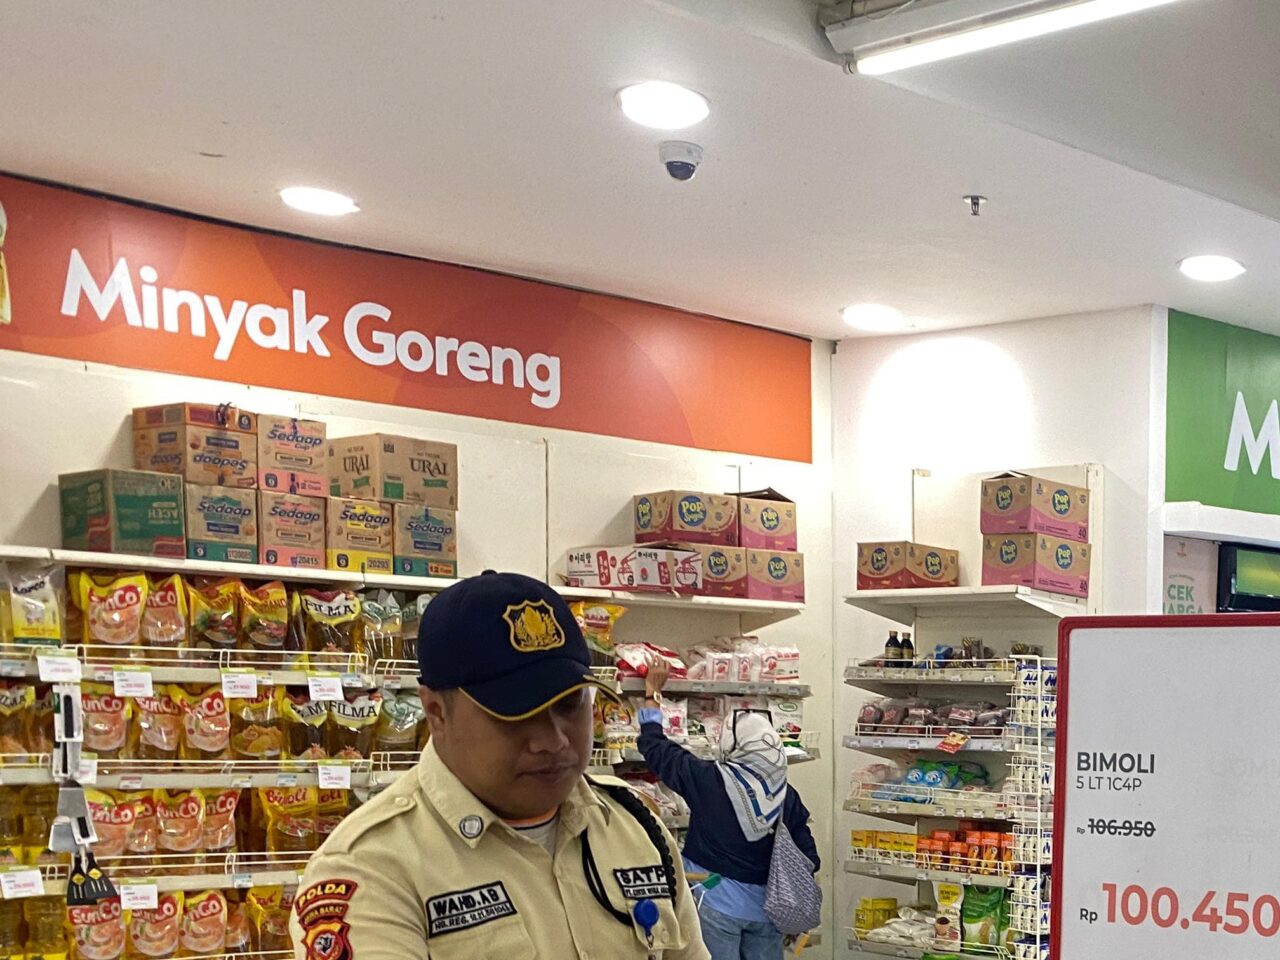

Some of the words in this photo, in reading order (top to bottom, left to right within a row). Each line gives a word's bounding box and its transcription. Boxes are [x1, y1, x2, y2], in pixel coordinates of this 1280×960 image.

[60, 247, 331, 361] Minyak
[343, 301, 561, 409] Goreng
[267, 429, 323, 447] Sedaap
[343, 454, 370, 475] URAI
[409, 457, 448, 476] URAI
[197, 501, 252, 517] Sedaap
[270, 506, 320, 522] Sedaap
[340, 510, 391, 527] Sedaap
[406, 520, 453, 536] Sedaap
[1167, 584, 1195, 602] CEK
[306, 599, 355, 617] FILMA
[1162, 602, 1204, 614] ARGA
[329, 700, 378, 718] FILMA
[1076, 751, 1156, 774] BIMOLI
[1076, 776, 1085, 790] 5
[1088, 776, 1104, 790] LT
[1107, 777, 1143, 791] 1C4P
[1076, 827, 1085, 835] Rp
[1088, 818, 1156, 838] 106.950
[299, 883, 347, 907] POLDA
[71, 903, 121, 925] SunCo
[1079, 908, 1098, 924] Rp
